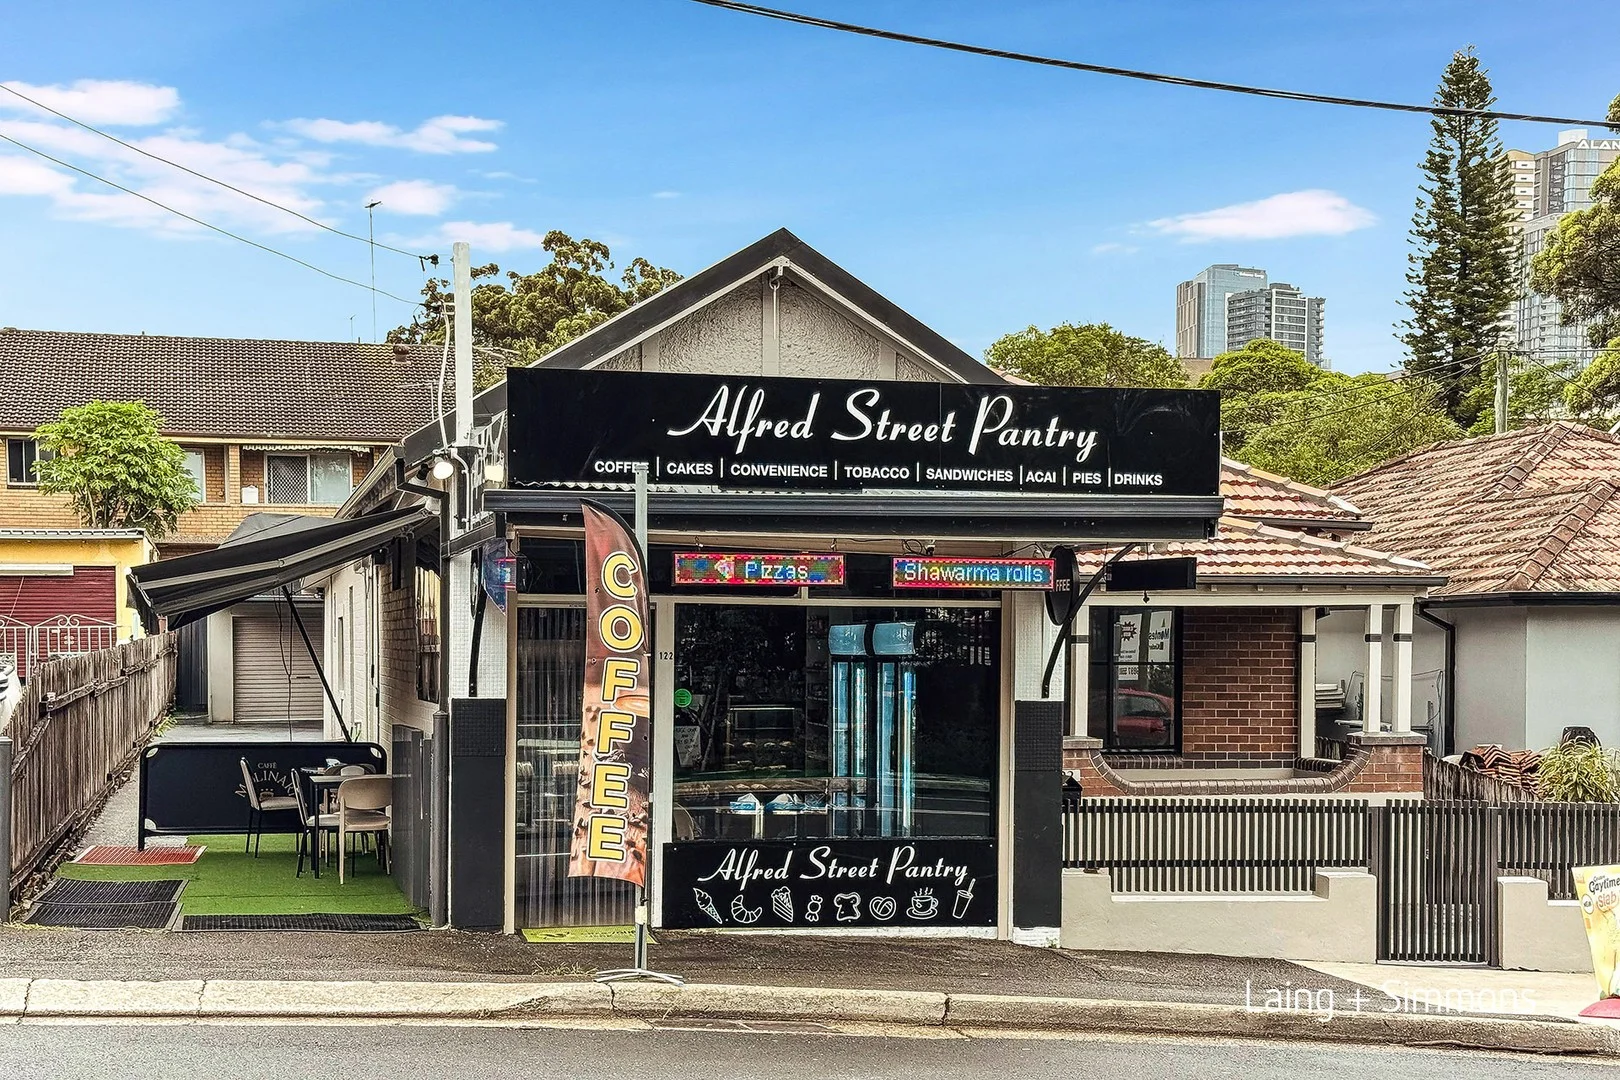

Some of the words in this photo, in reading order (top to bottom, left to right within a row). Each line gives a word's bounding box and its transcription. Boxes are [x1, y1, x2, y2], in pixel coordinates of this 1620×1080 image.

[667, 384, 821, 455] Alfred
[831, 388, 956, 443] Street
[968, 395, 1099, 463] Pantry
[666, 462, 714, 476] CAKES
[730, 463, 828, 478] CONVENIENCE
[844, 466, 910, 480] TOBACCO
[926, 468, 1014, 483] SANDWICHES
[1025, 471, 1057, 484] ACAI
[1072, 472, 1102, 485] PIES
[1114, 473, 1163, 487] DRINKS
[745, 561, 808, 580] Pizzas
[904, 563, 1000, 583] Shawarma
[1006, 565, 1043, 583] rolls
[1054, 578, 1072, 592] FFEE
[659, 651, 674, 660] 122
[587, 551, 645, 863] COFFEE
[235, 770, 295, 798] MLINARI
[698, 848, 793, 891] Alfred
[800, 845, 880, 880] Street
[886, 845, 968, 884] Pantry
[1597, 891, 1617, 908] Slab
